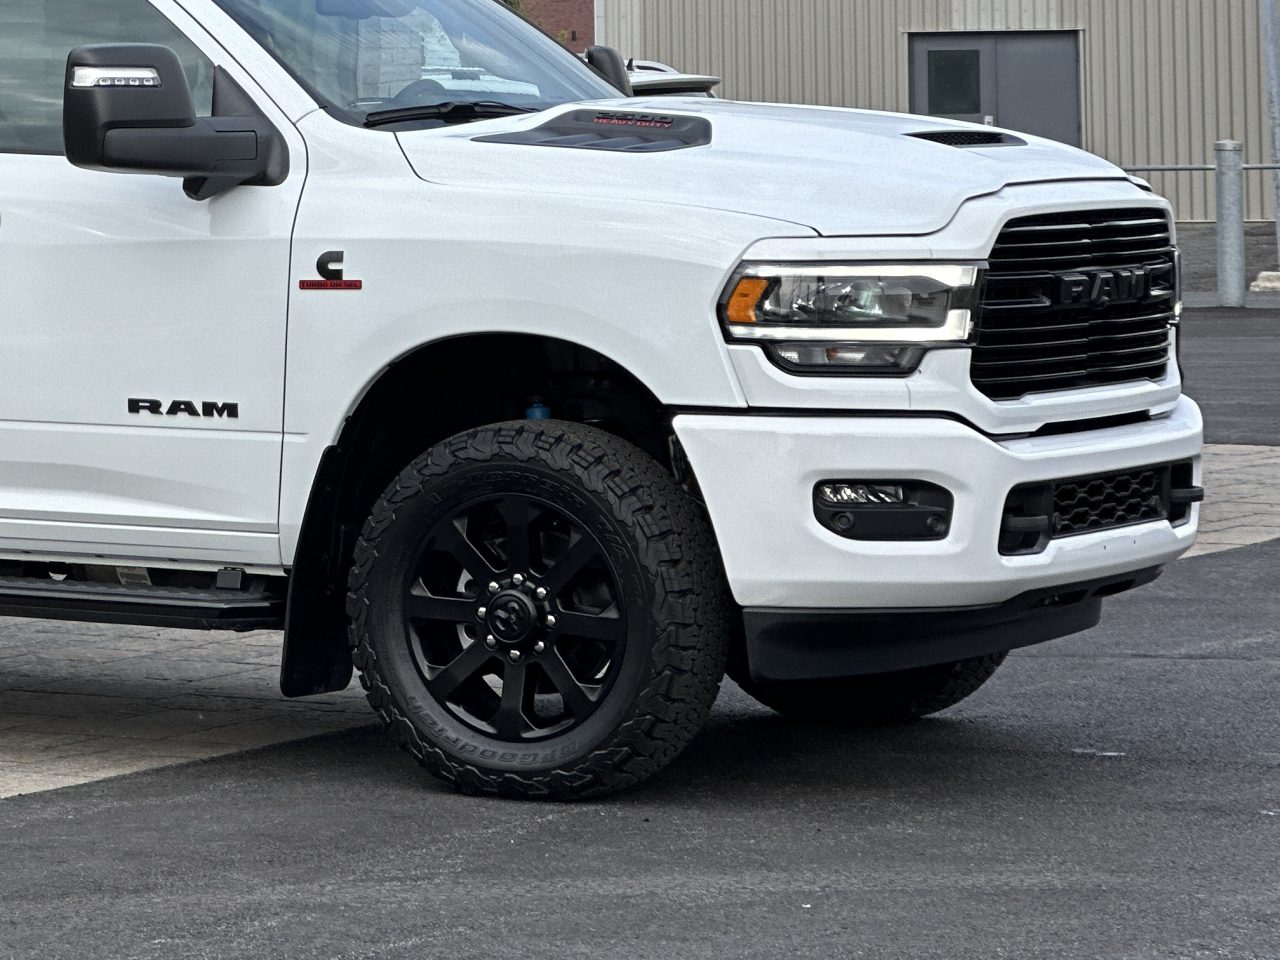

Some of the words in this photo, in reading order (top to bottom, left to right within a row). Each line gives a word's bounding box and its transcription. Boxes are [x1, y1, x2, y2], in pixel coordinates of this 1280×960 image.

[592, 117, 634, 126] HEAVY
[635, 121, 673, 129] DUTY
[127, 397, 240, 419] RAM
